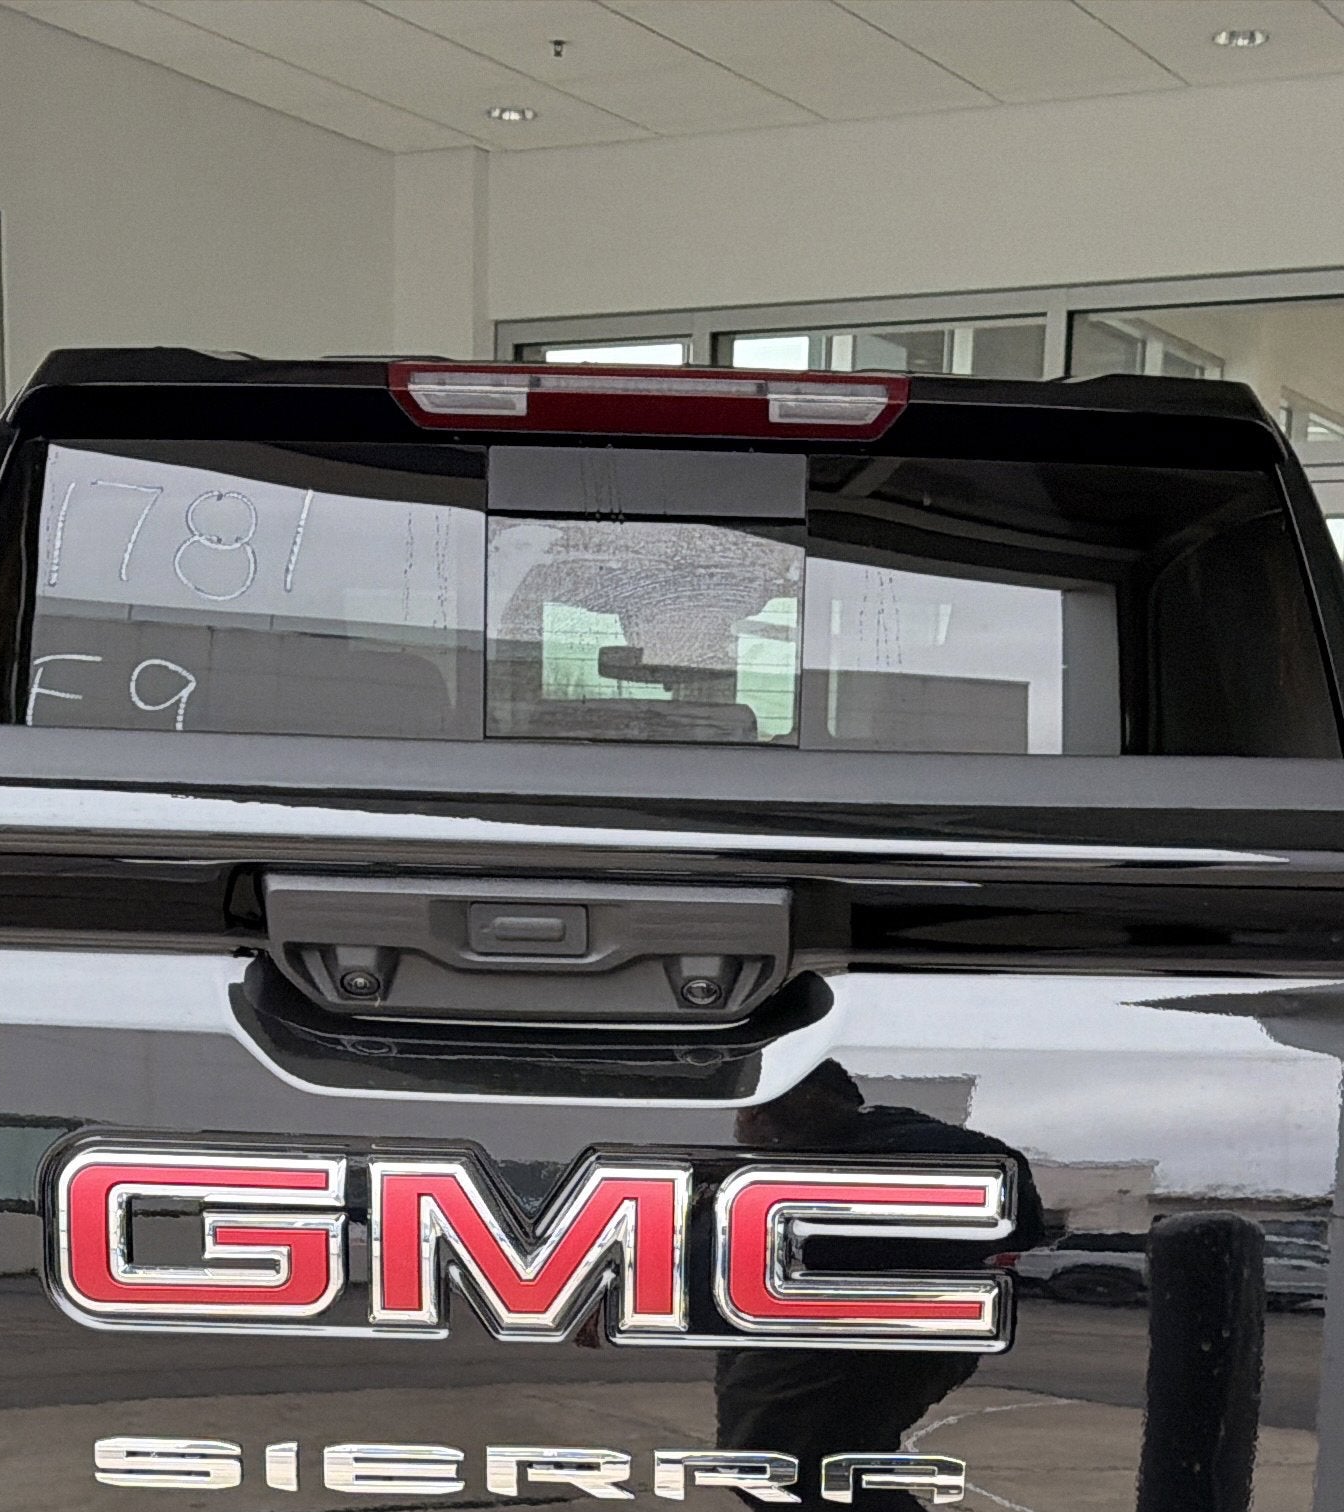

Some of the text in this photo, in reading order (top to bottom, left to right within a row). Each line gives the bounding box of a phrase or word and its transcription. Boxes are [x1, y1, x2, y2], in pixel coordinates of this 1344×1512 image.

[46, 478, 314, 601] 1781
[54, 1143, 1016, 1345] GMC
[93, 1434, 966, 1504] SIERRA
